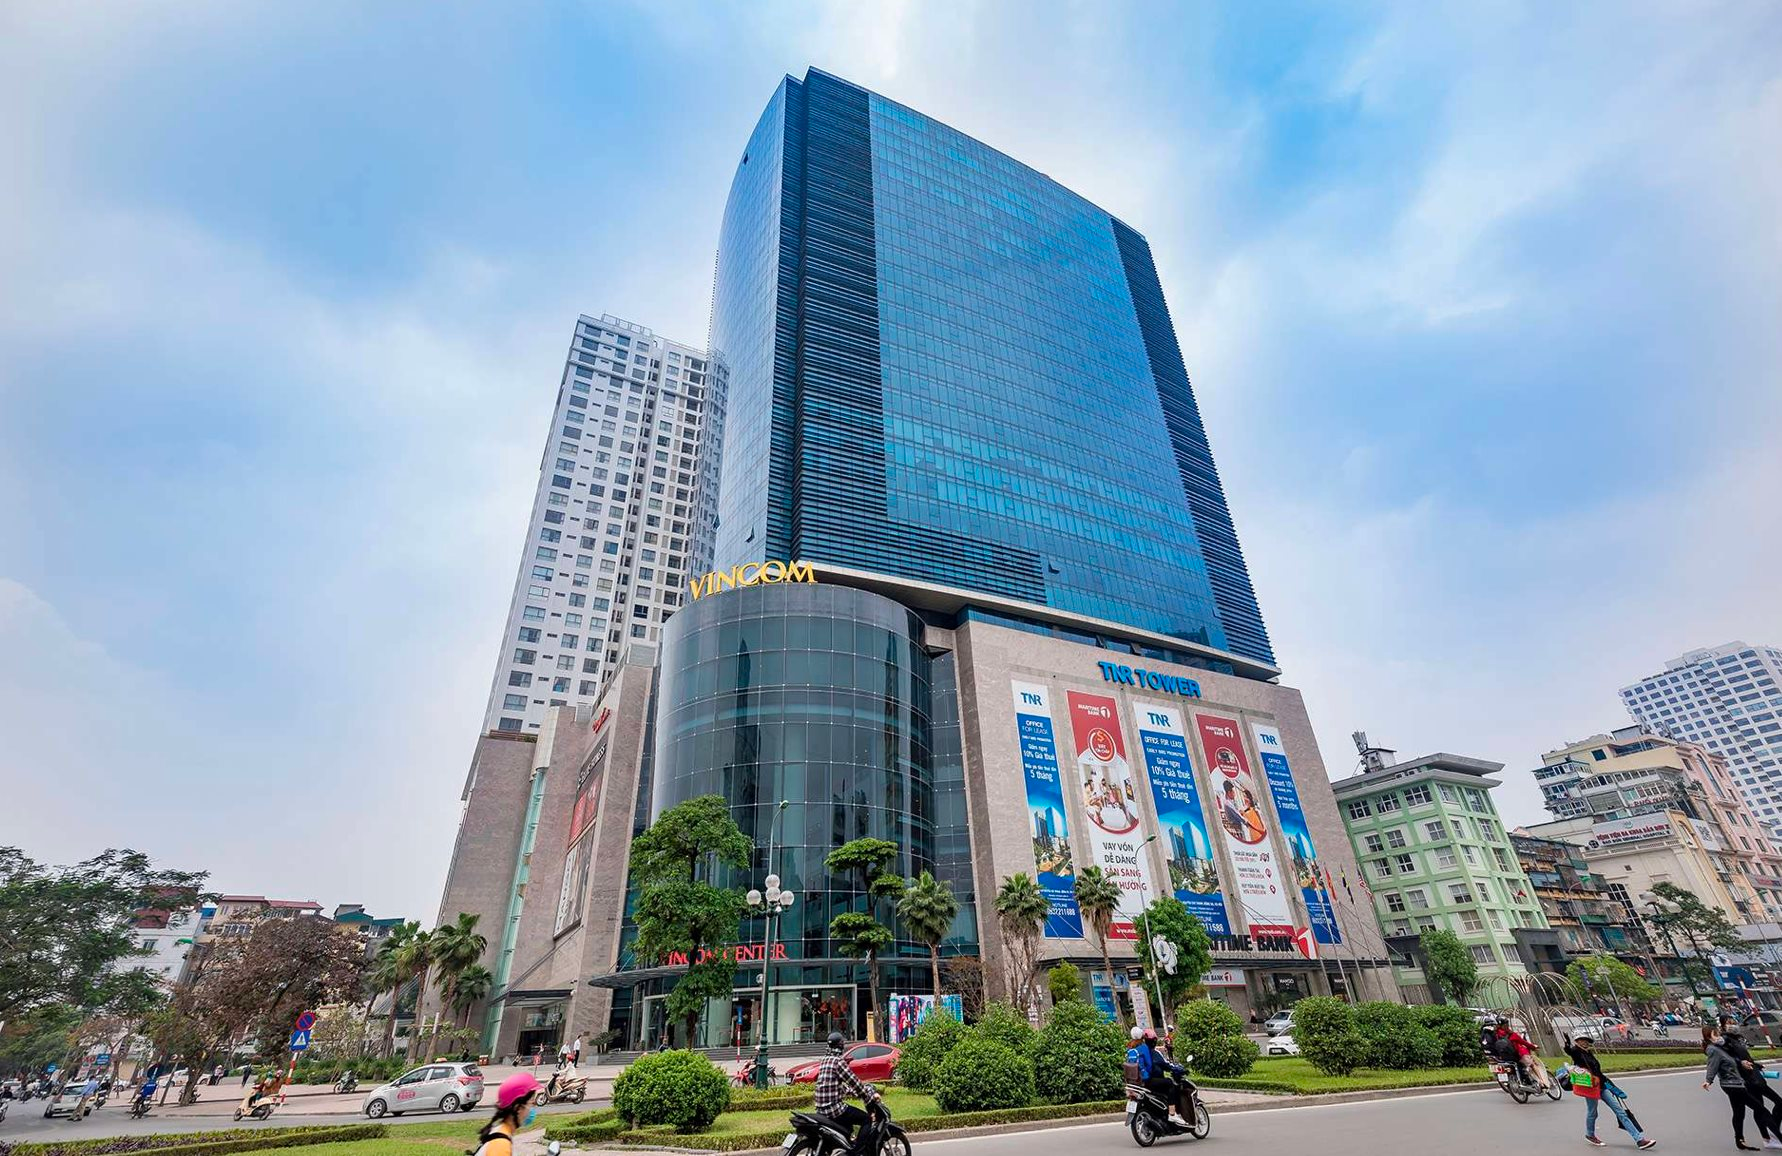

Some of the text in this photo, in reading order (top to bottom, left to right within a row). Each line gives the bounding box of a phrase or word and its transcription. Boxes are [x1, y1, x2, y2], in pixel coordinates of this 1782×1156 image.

[690, 560, 818, 601] VINCOM
[1097, 661, 1201, 698] TNR TOWER
[1020, 691, 1042, 706] TNR
[1147, 712, 1171, 727] TNR
[1260, 733, 1278, 746] TNR
[1030, 770, 1036, 778] 5
[1161, 787, 1168, 799] 5
[1103, 841, 1117, 851] VAY
[1257, 935, 1295, 952] BANK
